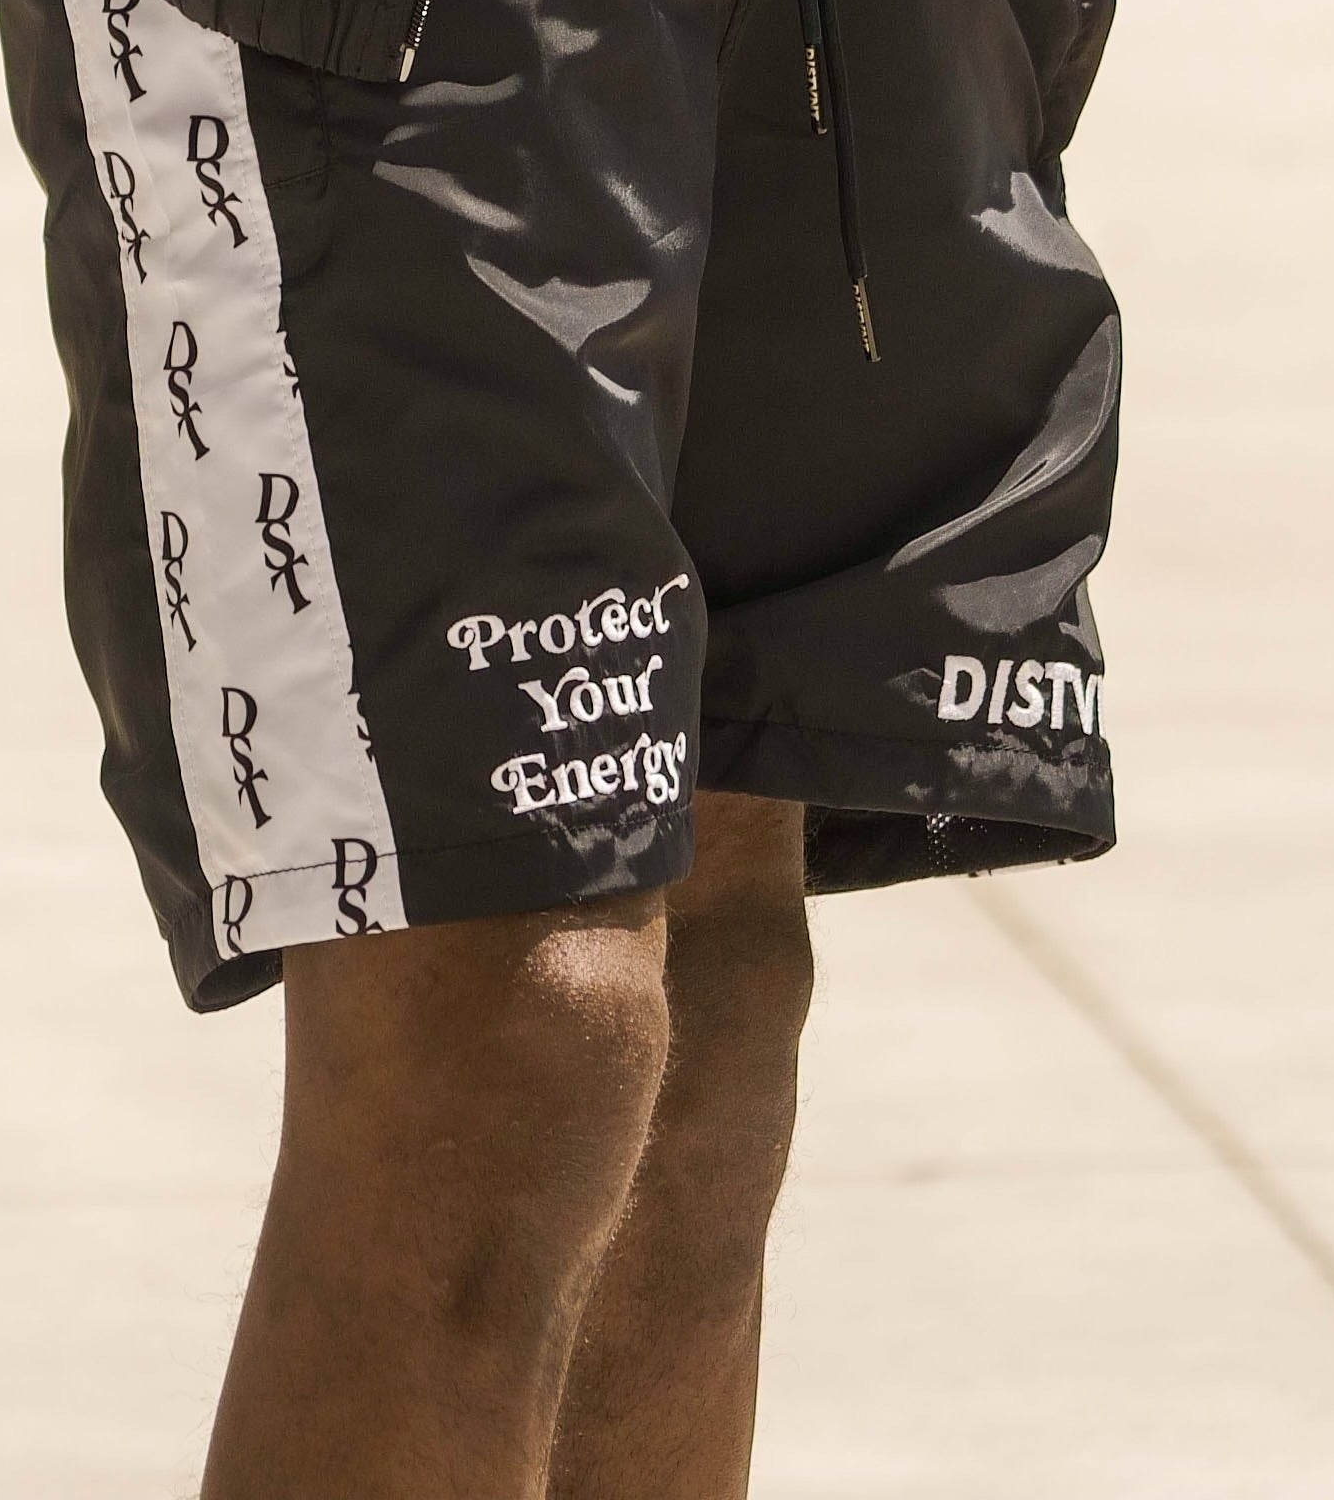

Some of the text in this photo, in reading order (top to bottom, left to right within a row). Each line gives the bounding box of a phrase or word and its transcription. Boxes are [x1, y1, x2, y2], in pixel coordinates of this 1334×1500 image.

[446, 573, 689, 671] Protect
[518, 655, 662, 733] Your
[491, 732, 687, 815] Energy
